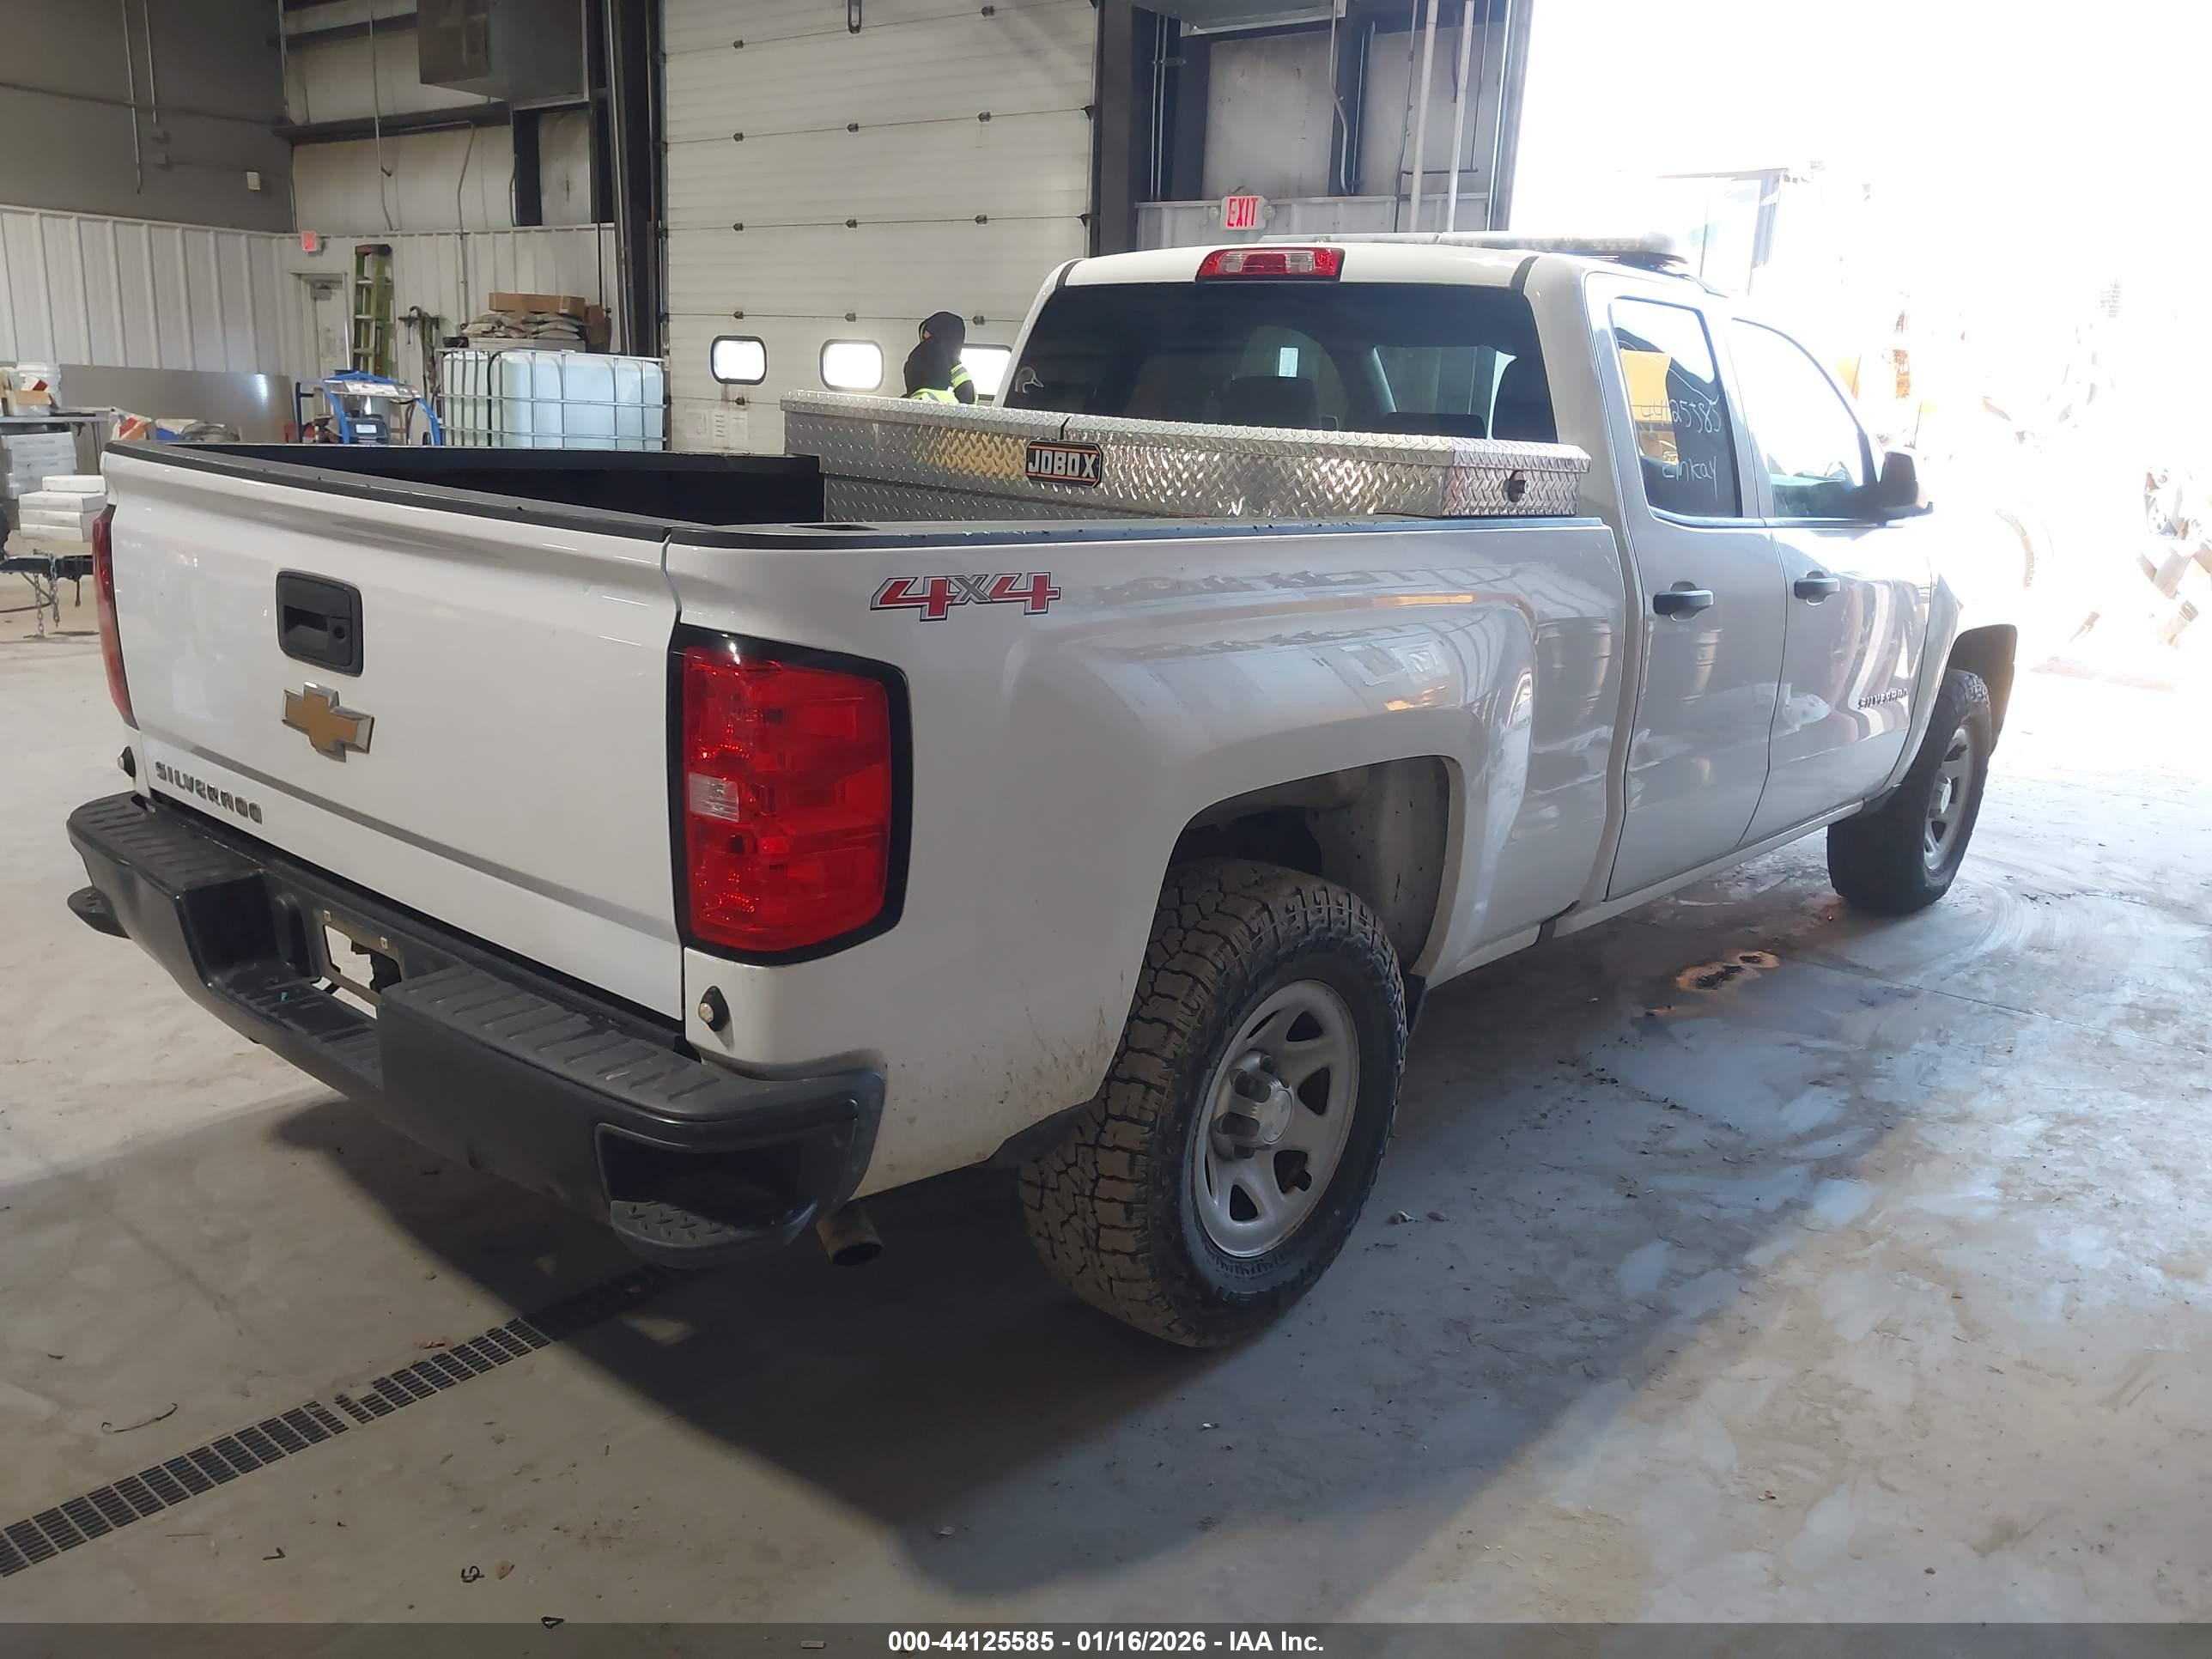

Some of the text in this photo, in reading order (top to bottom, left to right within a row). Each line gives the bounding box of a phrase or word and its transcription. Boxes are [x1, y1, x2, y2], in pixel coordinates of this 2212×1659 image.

[1227, 198, 1258, 227] EXIT
[1028, 449, 1097, 478] JOBOX
[155, 761, 263, 824] SILVERADO
